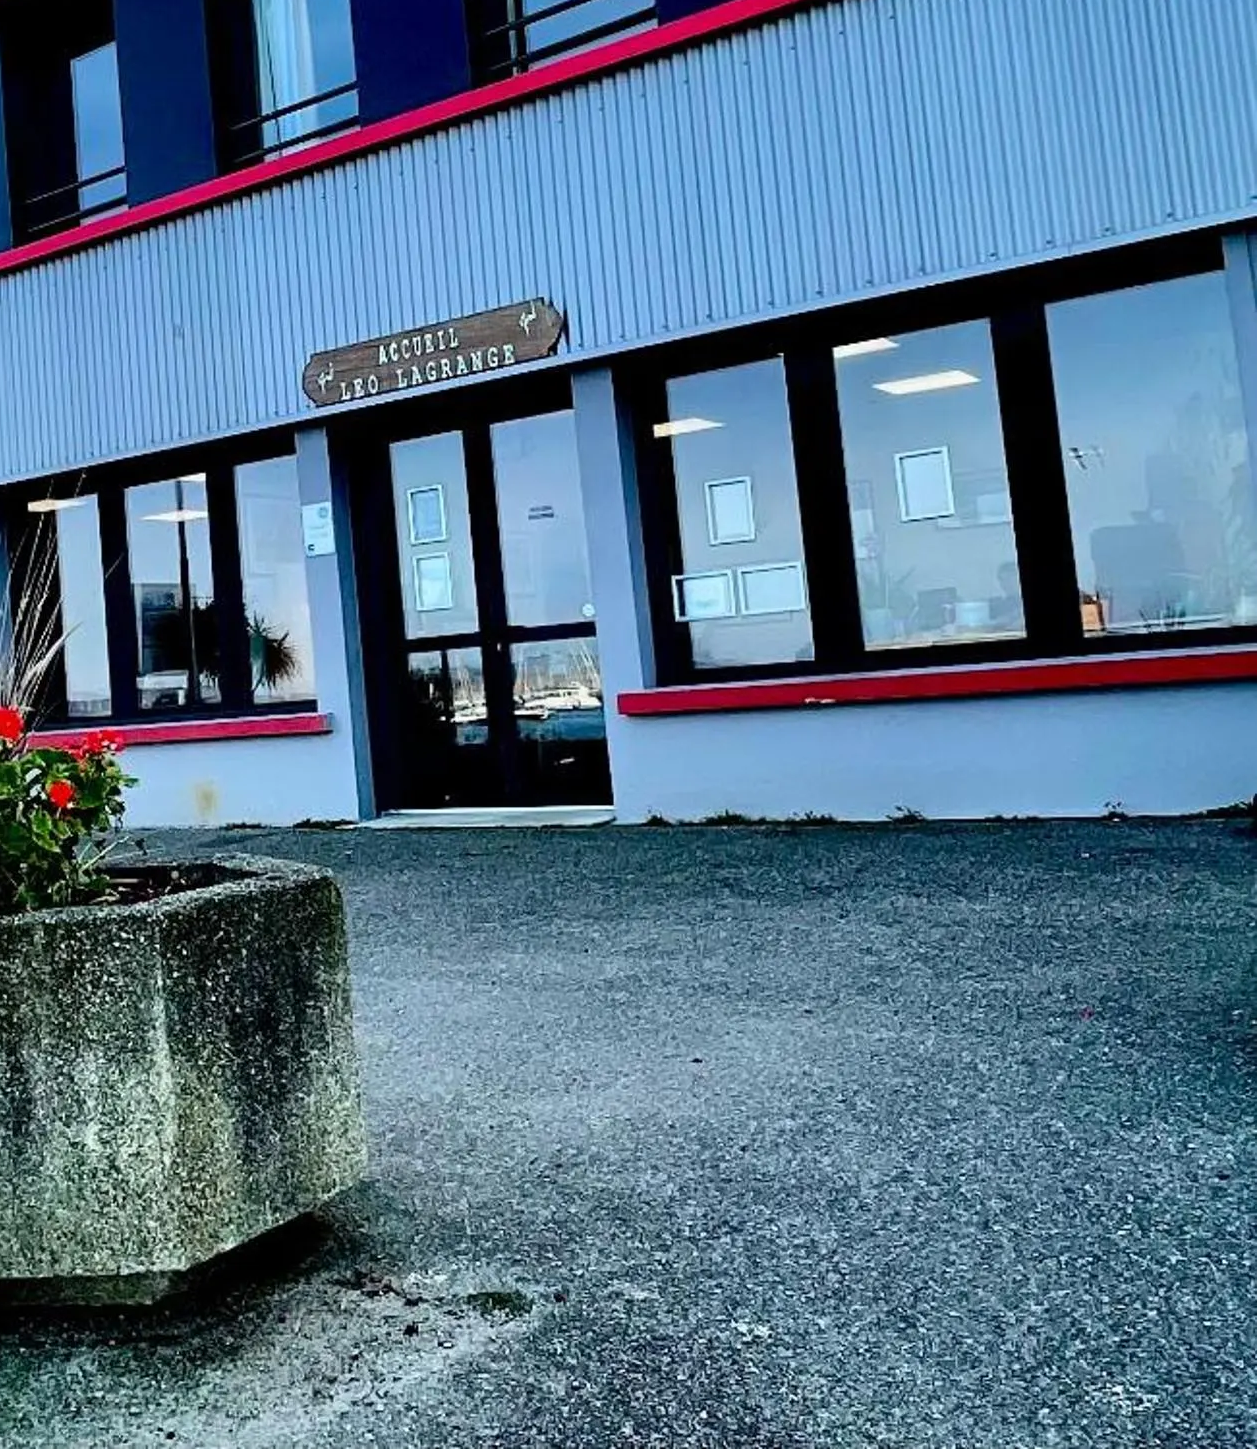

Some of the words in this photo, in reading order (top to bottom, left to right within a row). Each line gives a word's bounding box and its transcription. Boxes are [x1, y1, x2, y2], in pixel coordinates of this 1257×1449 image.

[378, 328, 459, 365] ACCUEIL
[340, 375, 379, 401] LEO
[396, 344, 516, 389] LAGRANGE
